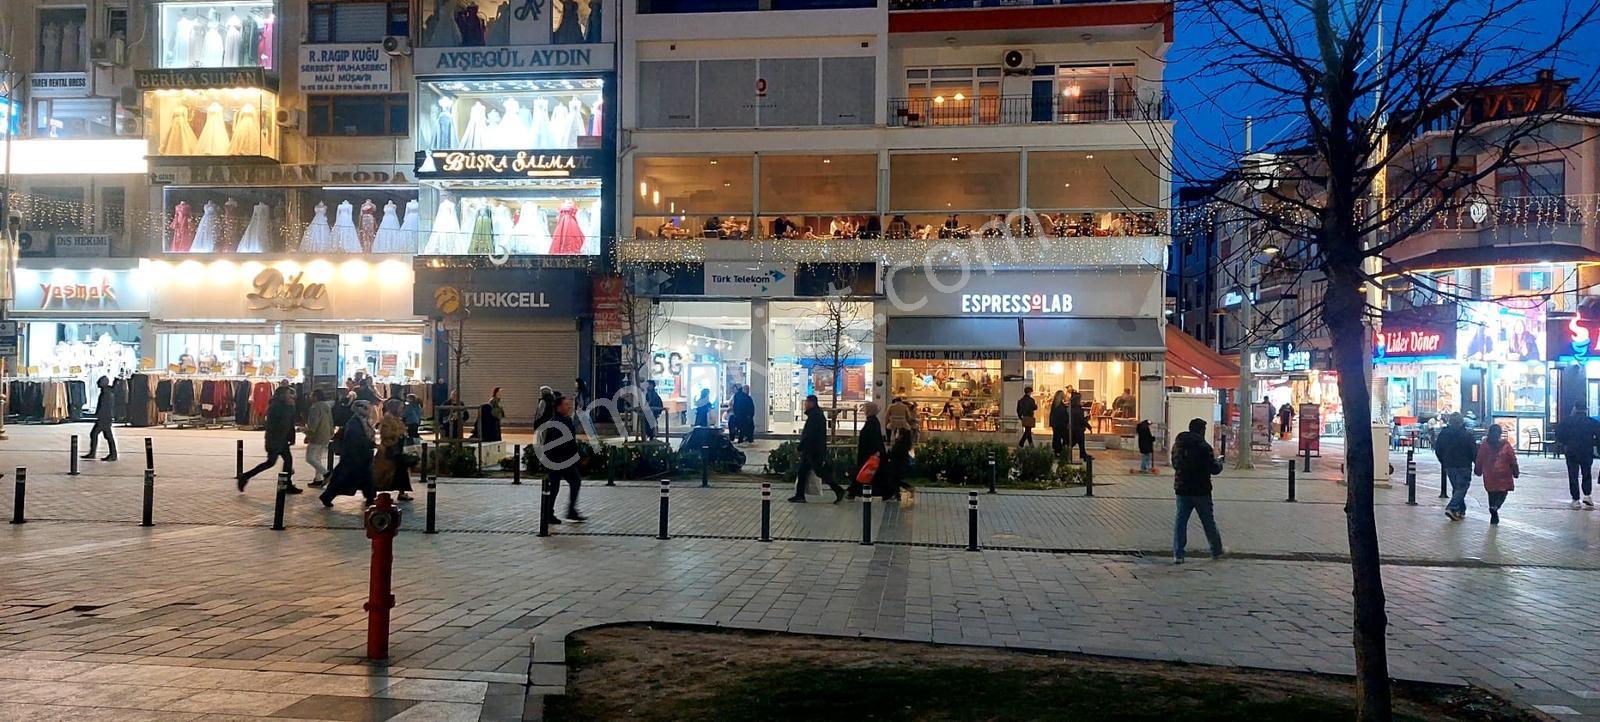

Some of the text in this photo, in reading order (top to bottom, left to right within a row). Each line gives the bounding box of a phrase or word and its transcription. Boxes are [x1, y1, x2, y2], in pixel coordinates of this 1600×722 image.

[352, 47, 379, 61] KUĞU
[436, 48, 591, 71] AYŞEGÜL AYDIN
[301, 64, 334, 72] SERBEST
[140, 70, 257, 87] BERİKA SULTAN
[443, 152, 508, 172] BÜŞRA
[331, 170, 408, 183] MODA
[712, 274, 770, 284] Türk Telekom
[463, 292, 550, 308] TURKCELL
[1386, 331, 1440, 353] Lider Döner
[899, 350, 1008, 360] ROASTED WITH PASSION
[1038, 351, 1077, 361] ROASTED
[1084, 351, 1107, 361] WITH
